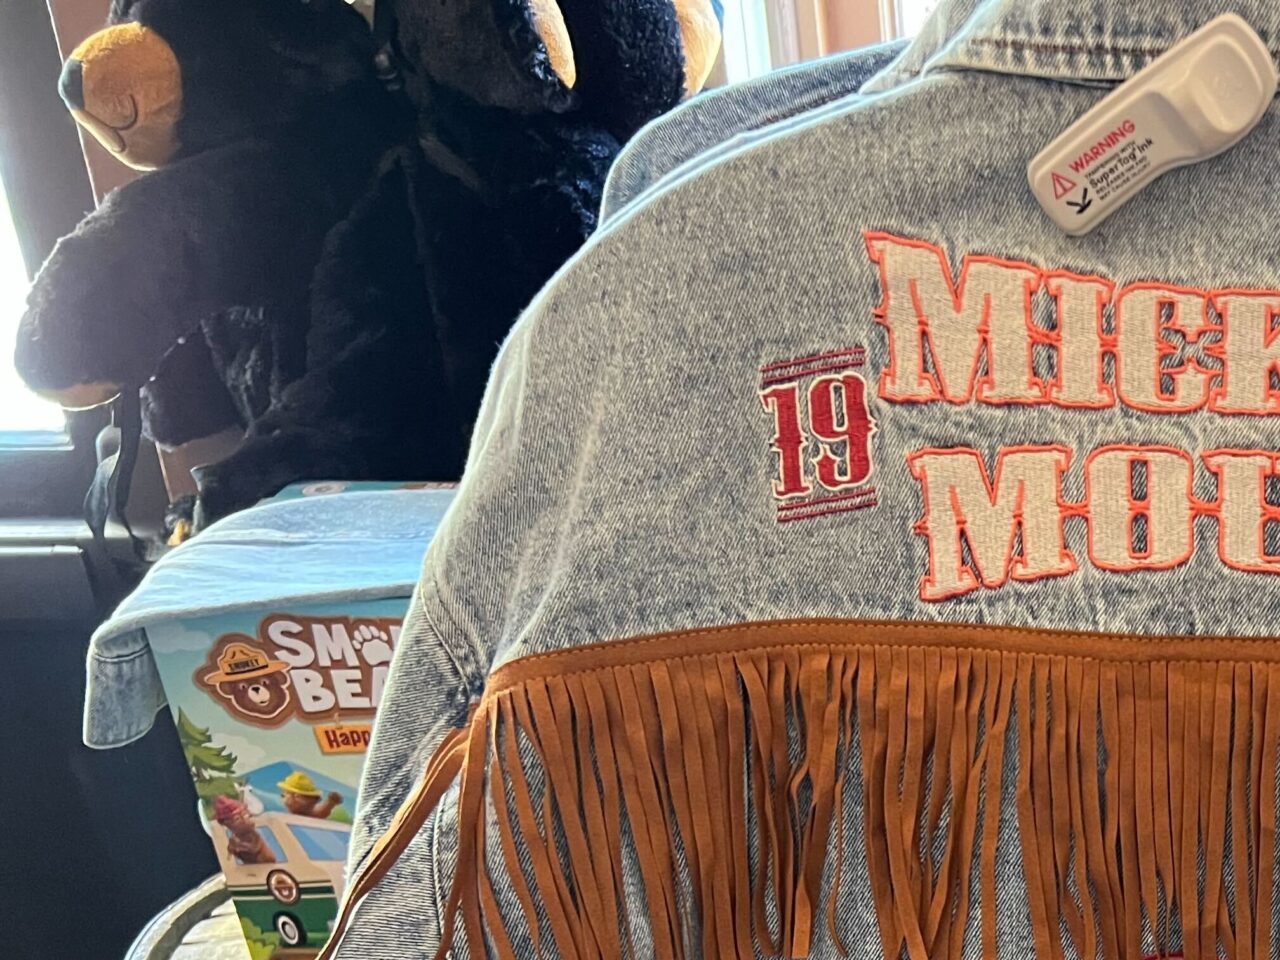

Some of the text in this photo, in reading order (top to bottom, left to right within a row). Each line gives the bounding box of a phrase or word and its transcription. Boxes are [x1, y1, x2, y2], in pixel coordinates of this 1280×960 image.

[1068, 119, 1136, 173] WARNING
[1137, 137, 1154, 153] Ink
[758, 373, 877, 500] 19
